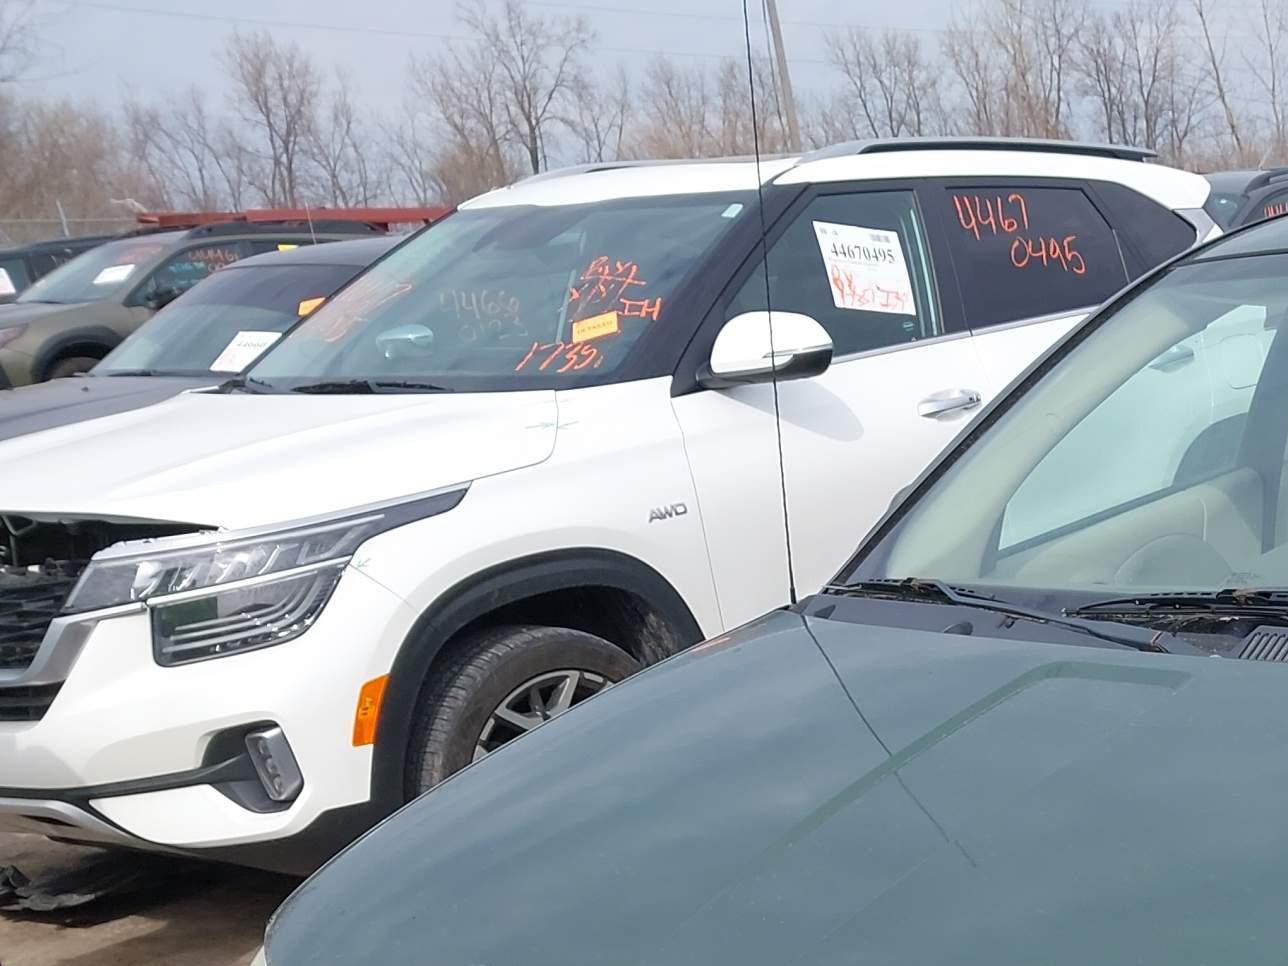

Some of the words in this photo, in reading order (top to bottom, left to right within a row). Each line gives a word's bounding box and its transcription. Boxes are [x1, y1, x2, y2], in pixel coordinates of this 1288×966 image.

[952, 193, 1029, 240] 4467
[830, 241, 896, 264] 44670495
[1010, 235, 1086, 274] 0495
[648, 502, 688, 523] AWD
